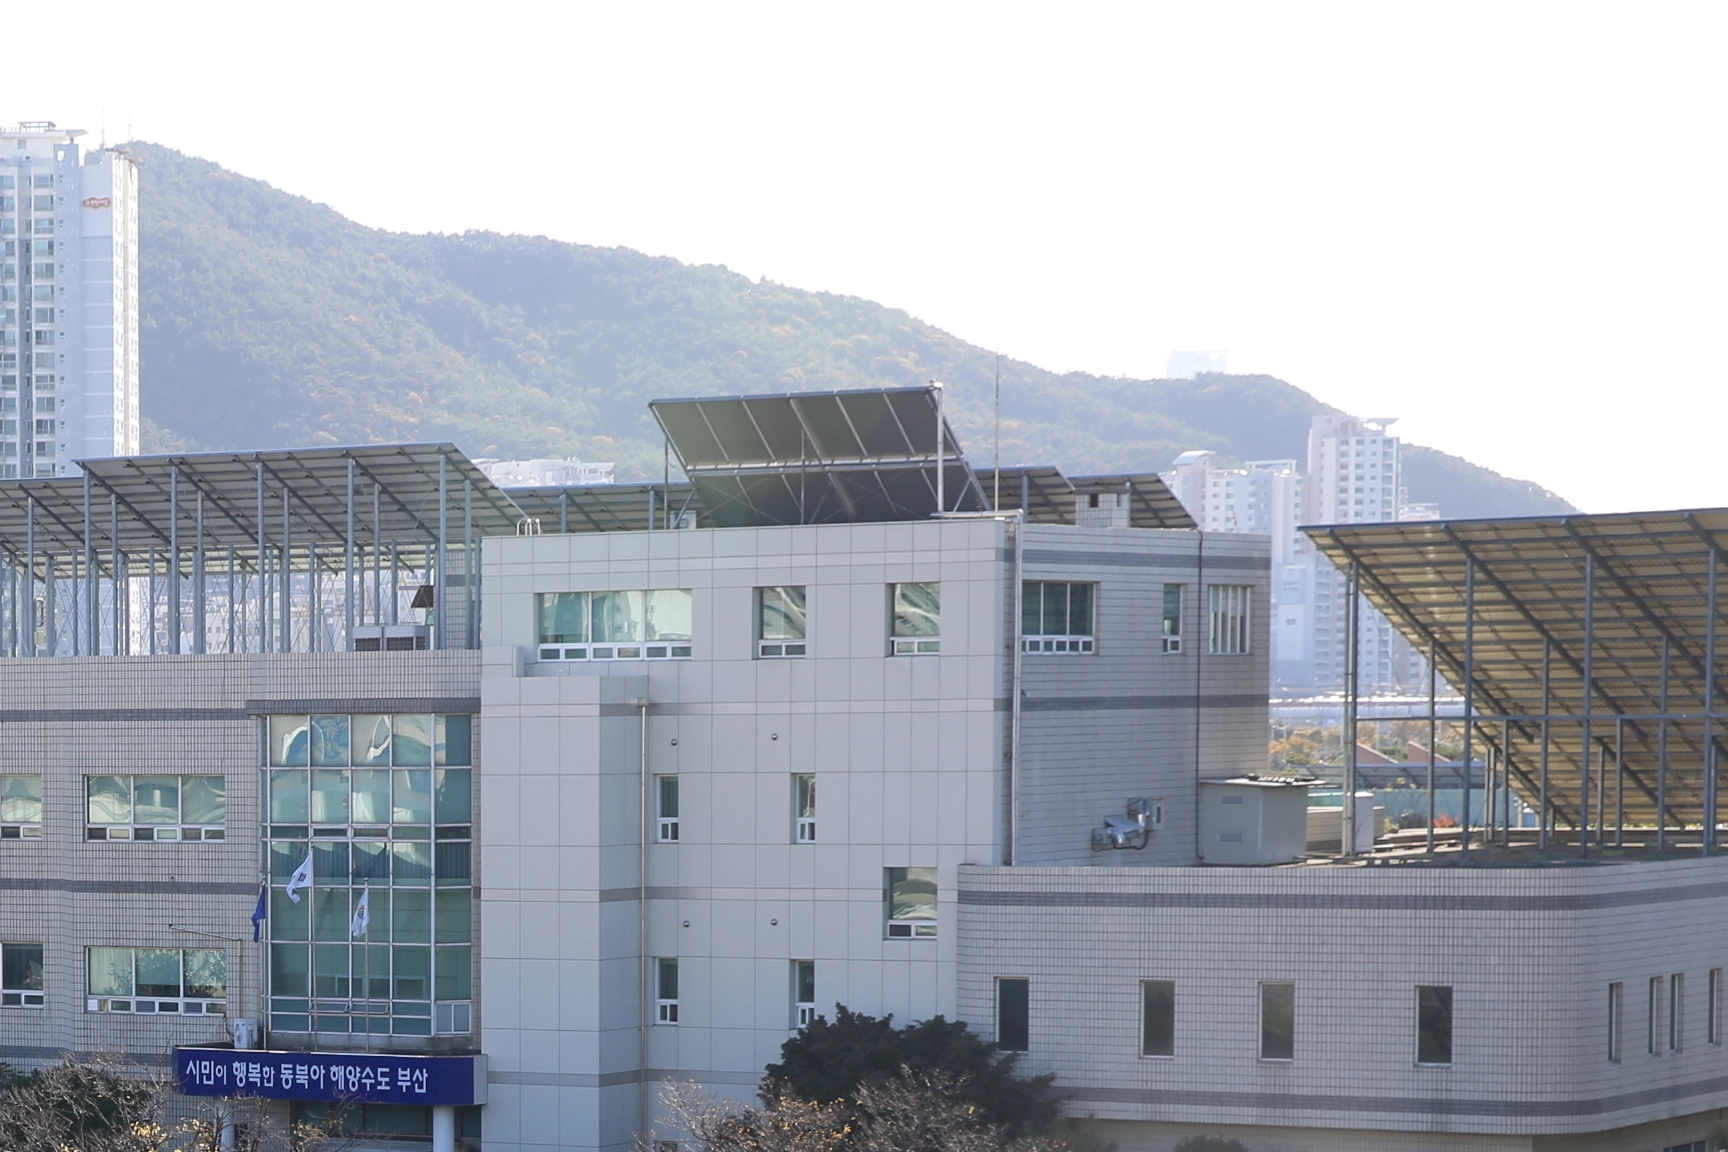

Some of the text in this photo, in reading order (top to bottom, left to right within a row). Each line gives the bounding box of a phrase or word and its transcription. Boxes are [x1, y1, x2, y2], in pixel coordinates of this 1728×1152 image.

[186, 1060, 428, 1094] 시민이 행복한 동북아 해양수도 부산
